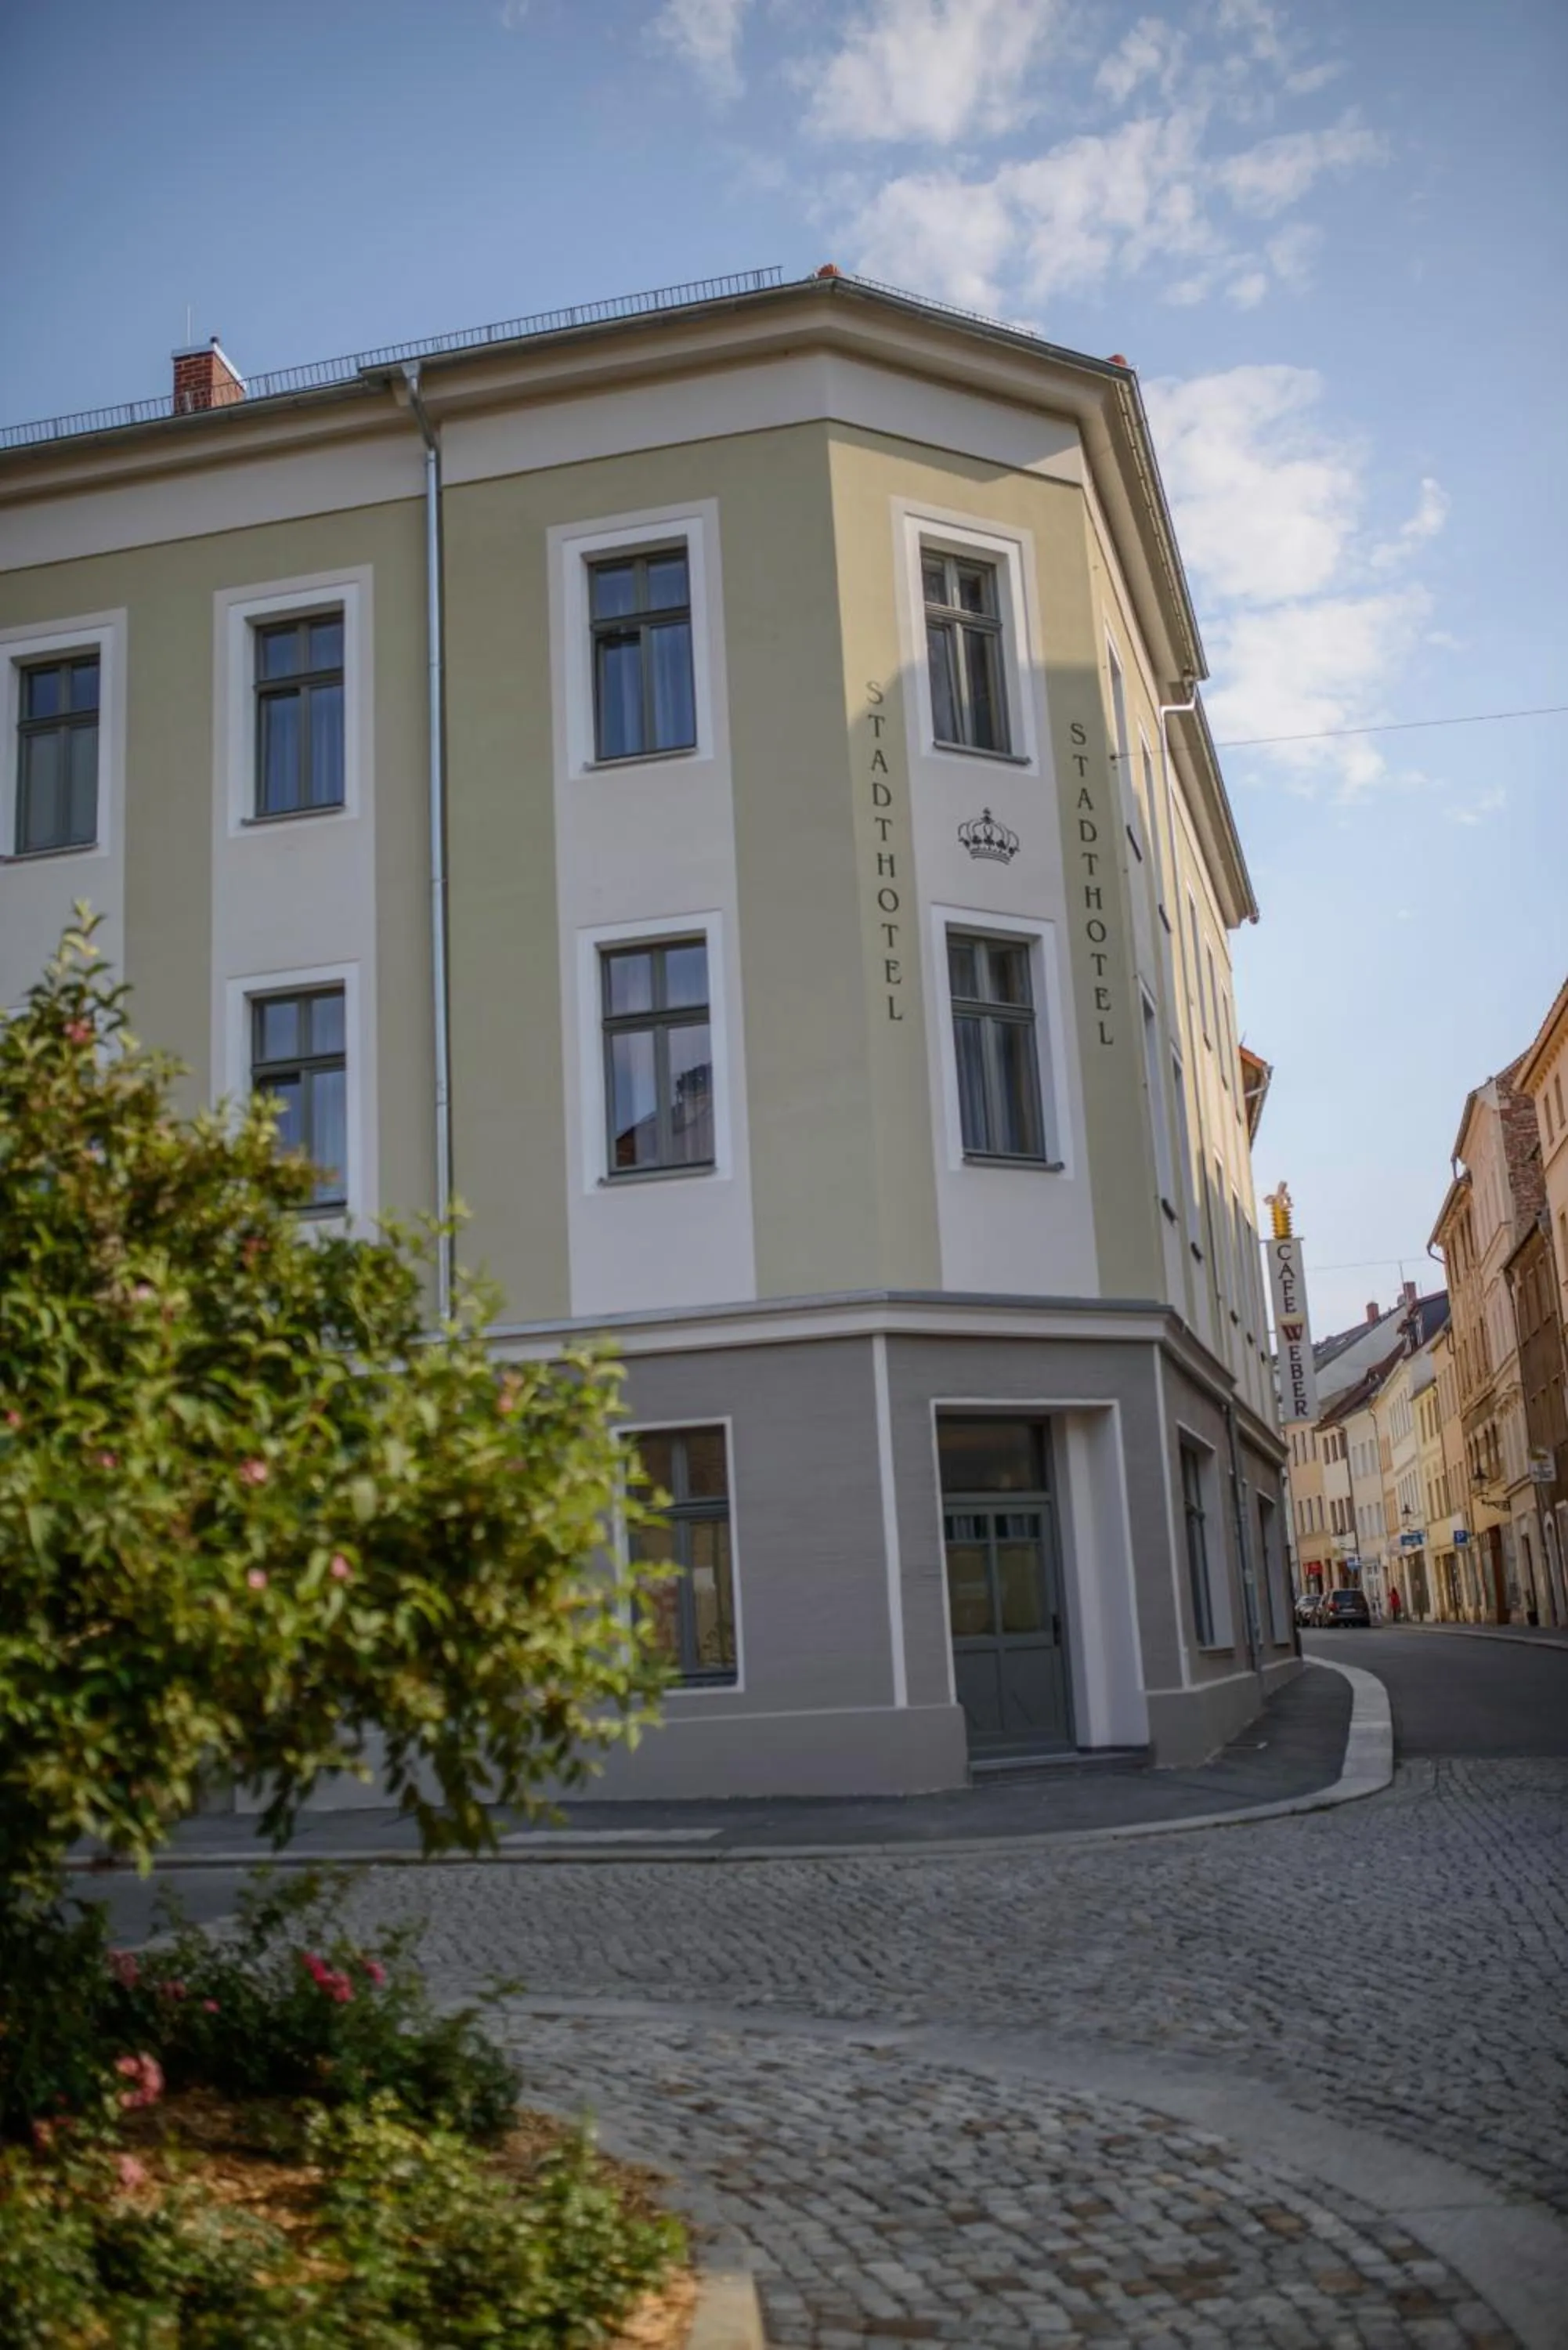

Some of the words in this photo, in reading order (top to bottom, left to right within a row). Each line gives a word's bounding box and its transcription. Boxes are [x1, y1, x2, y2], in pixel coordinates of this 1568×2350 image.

[866, 681, 903, 1021] STADTHOTEL
[1070, 723, 1113, 1045] STADTHOTEL
[1277, 1244, 1296, 1313] CAFE
[1281, 1324, 1308, 1417] WEBER
